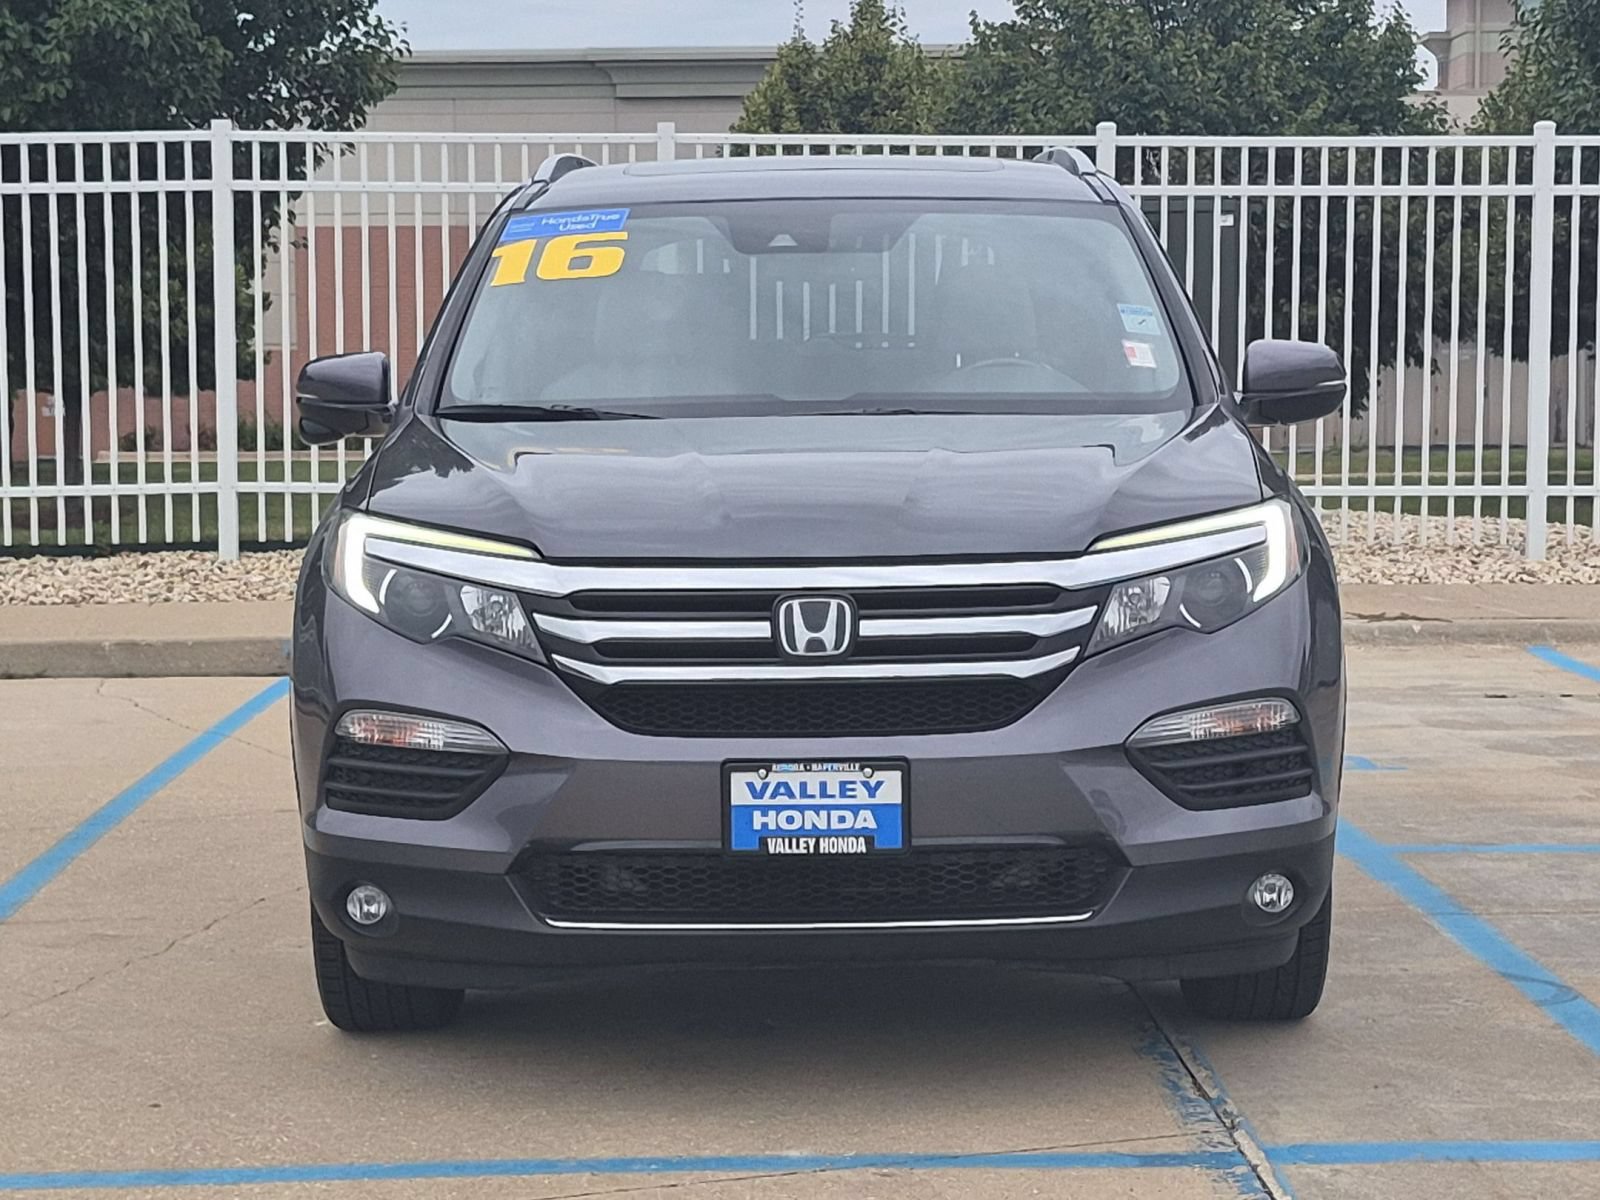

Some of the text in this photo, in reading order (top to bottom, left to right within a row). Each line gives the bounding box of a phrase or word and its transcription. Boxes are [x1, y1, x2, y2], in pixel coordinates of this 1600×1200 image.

[559, 221, 597, 231] Used
[490, 231, 628, 287] 16
[745, 780, 885, 800] VALLEY
[753, 809, 877, 830] HONDA
[767, 837, 867, 854] VALLEY HONDA
